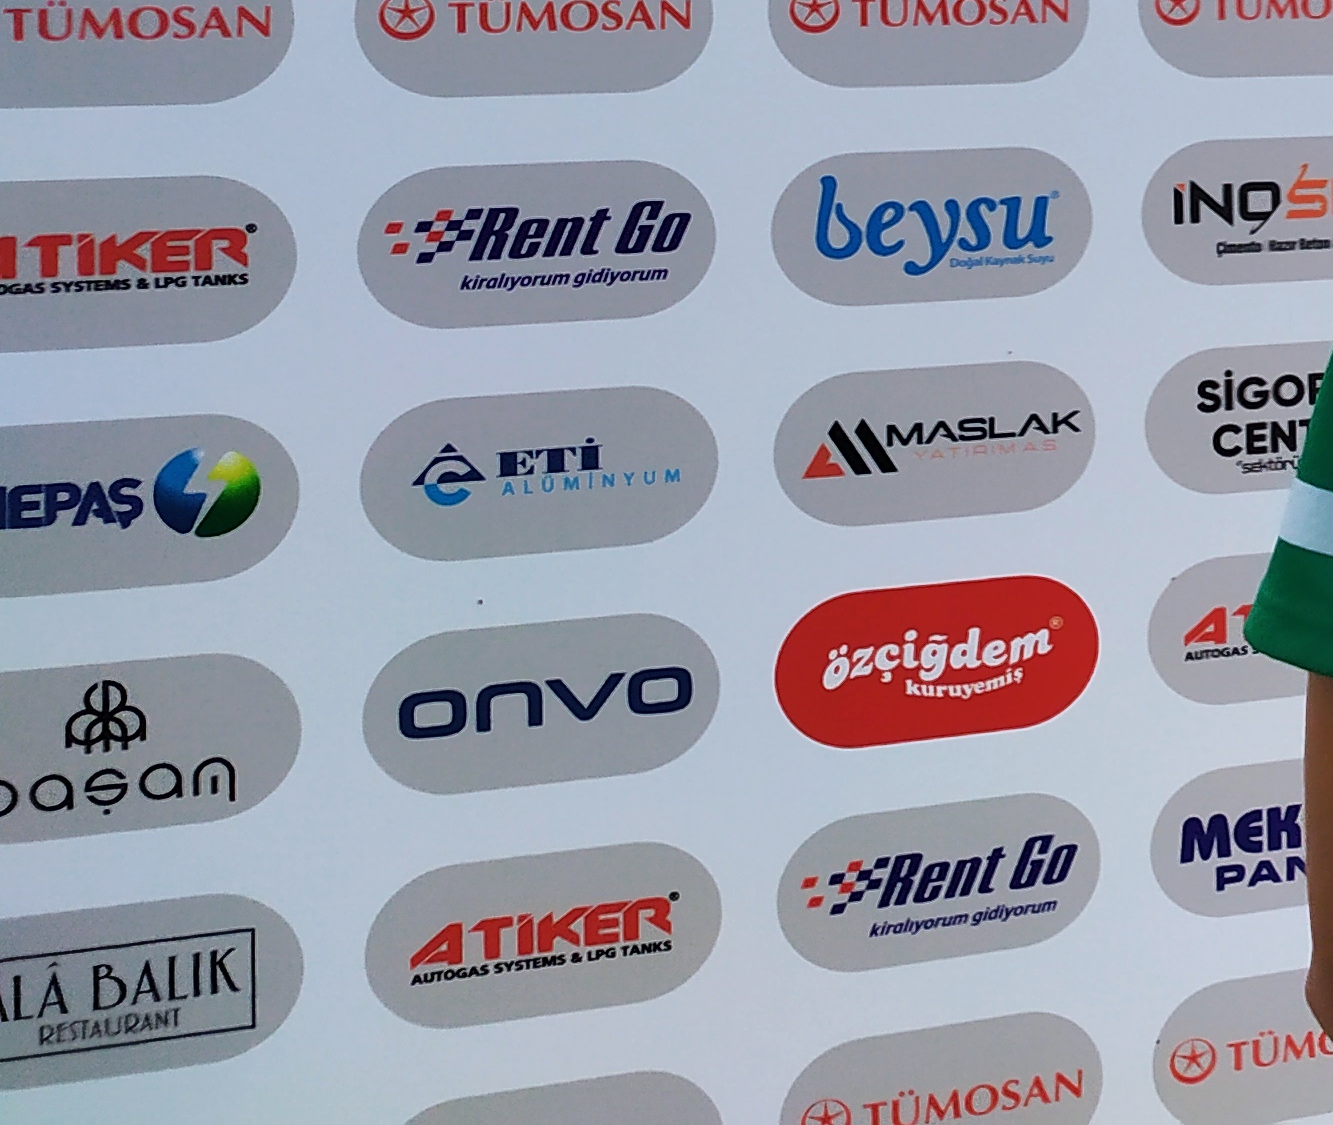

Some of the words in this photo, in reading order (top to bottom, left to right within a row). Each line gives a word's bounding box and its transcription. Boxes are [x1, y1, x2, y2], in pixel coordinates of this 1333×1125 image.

[4, 0, 272, 43] TÜMOSAN
[468, 207, 612, 261] Rent
[614, 200, 692, 255] Go
[815, 175, 1054, 276] beysu
[50, 278, 131, 293] SYSTEMS
[137, 277, 150, 290] &
[155, 276, 187, 289] LPG
[192, 273, 249, 287] TANKS
[573, 268, 669, 289] gidiyorum
[886, 410, 1081, 448] MASLAK
[496, 436, 603, 478] ETİ
[0, 477, 144, 530] EPAŞ
[502, 468, 682, 497] ALÜMİNYUM
[822, 627, 1053, 691] özçiğdem
[1184, 645, 1249, 662] AUTOGAS
[905, 667, 1024, 699] kuruyemiş
[877, 846, 1006, 909] Rent
[1009, 834, 1079, 890] Go
[971, 900, 1058, 926] gidiyorum
[92, 947, 240, 1011] BALIK
[410, 965, 490, 986] AUTOGAS
[494, 954, 566, 975] SYSTEMS
[570, 951, 583, 964] &
[587, 947, 616, 962] LPG
[621, 940, 673, 958] TANKS
[38, 1007, 182, 1046] RESTAURANT
[863, 1069, 1084, 1125] TÜMOSAN
